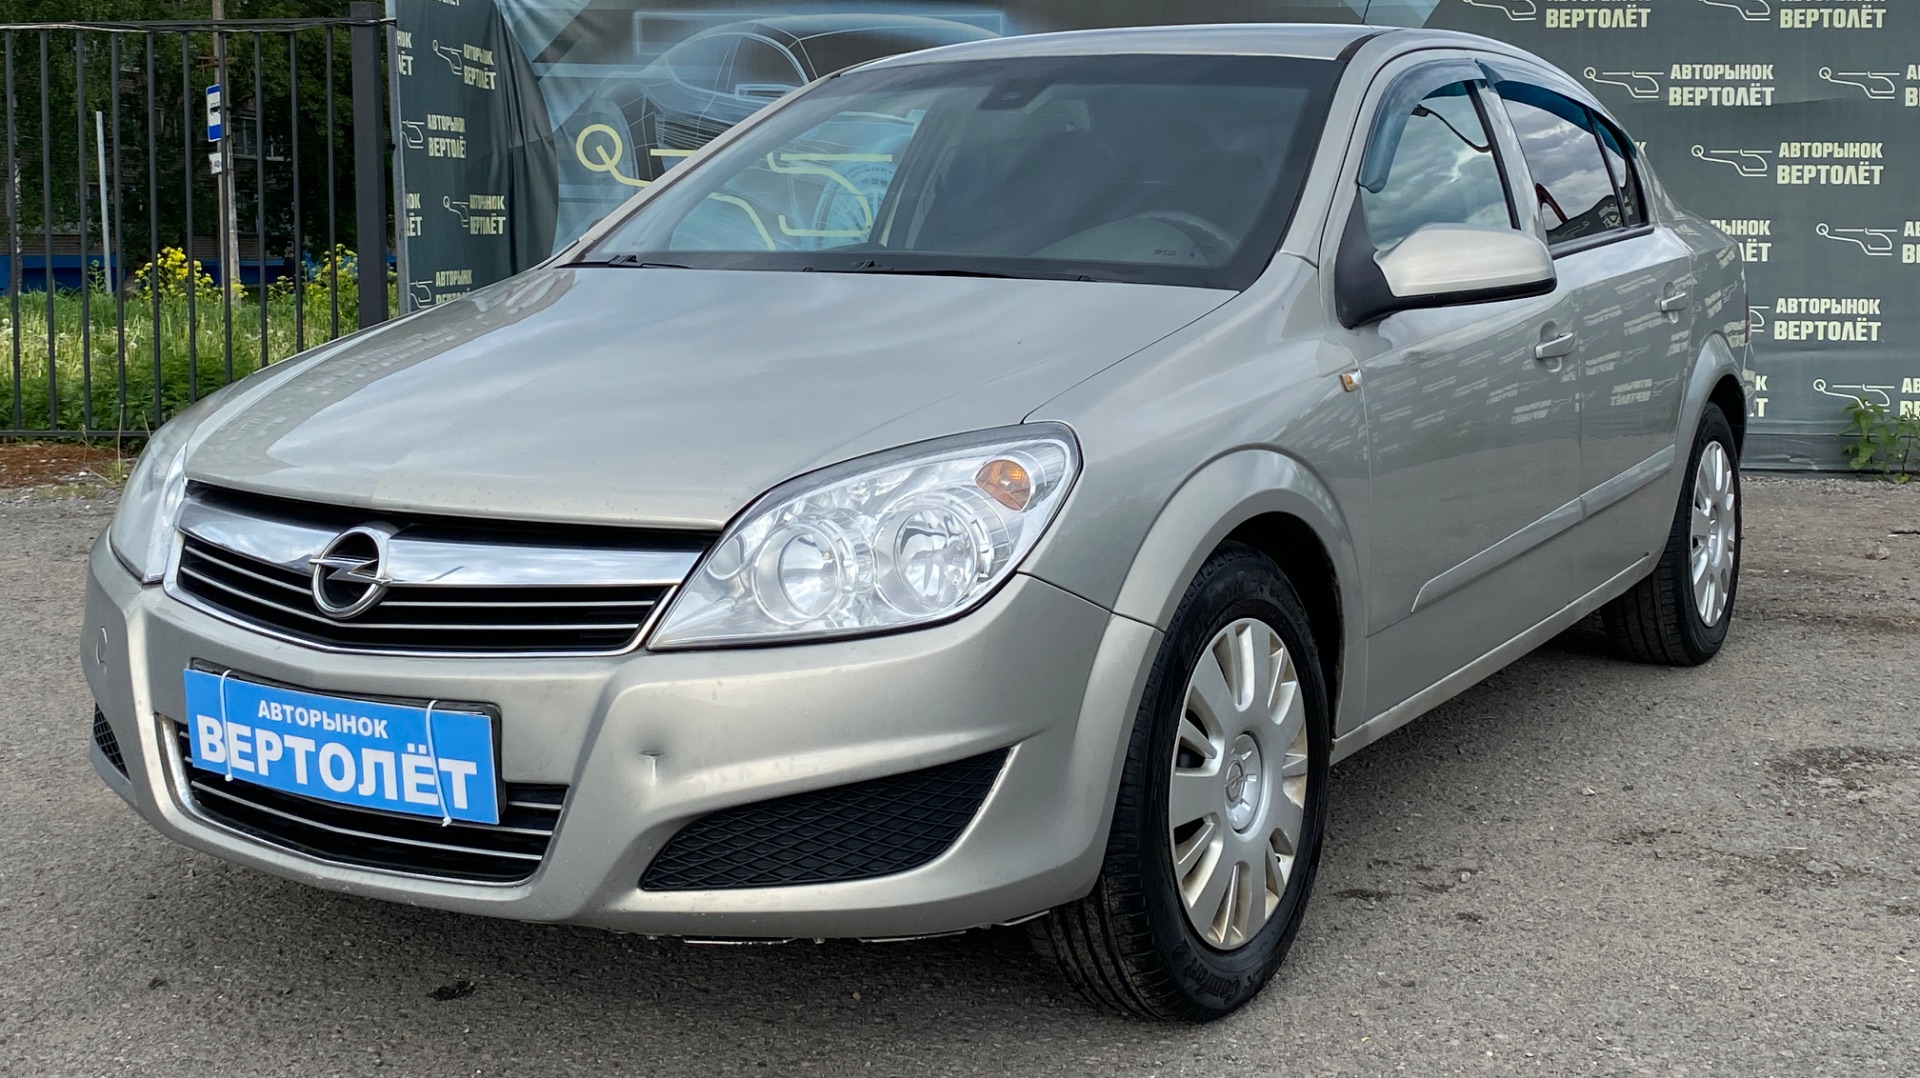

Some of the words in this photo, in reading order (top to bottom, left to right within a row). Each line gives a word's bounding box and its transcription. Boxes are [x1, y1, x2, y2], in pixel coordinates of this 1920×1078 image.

[1545, 4, 1651, 28] ВЕРТОЛЁТ
[1780, 4, 1886, 28] ВЕРТОЛЁТ
[1670, 64, 1774, 80] АВТОРЫНОК
[1668, 82, 1775, 106] ВЕРТОЛЁТ
[1778, 142, 1884, 158] АВТОРЫНОК
[1776, 160, 1884, 185] ВЕРТОЛЁТ
[1776, 298, 1881, 315] АВТОРЫНОК
[1774, 317, 1882, 341] ВЕРТОЛЁТ
[258, 700, 388, 739] АВТОРЫНОК
[197, 714, 477, 810] ВЕРТОЛЁТ
